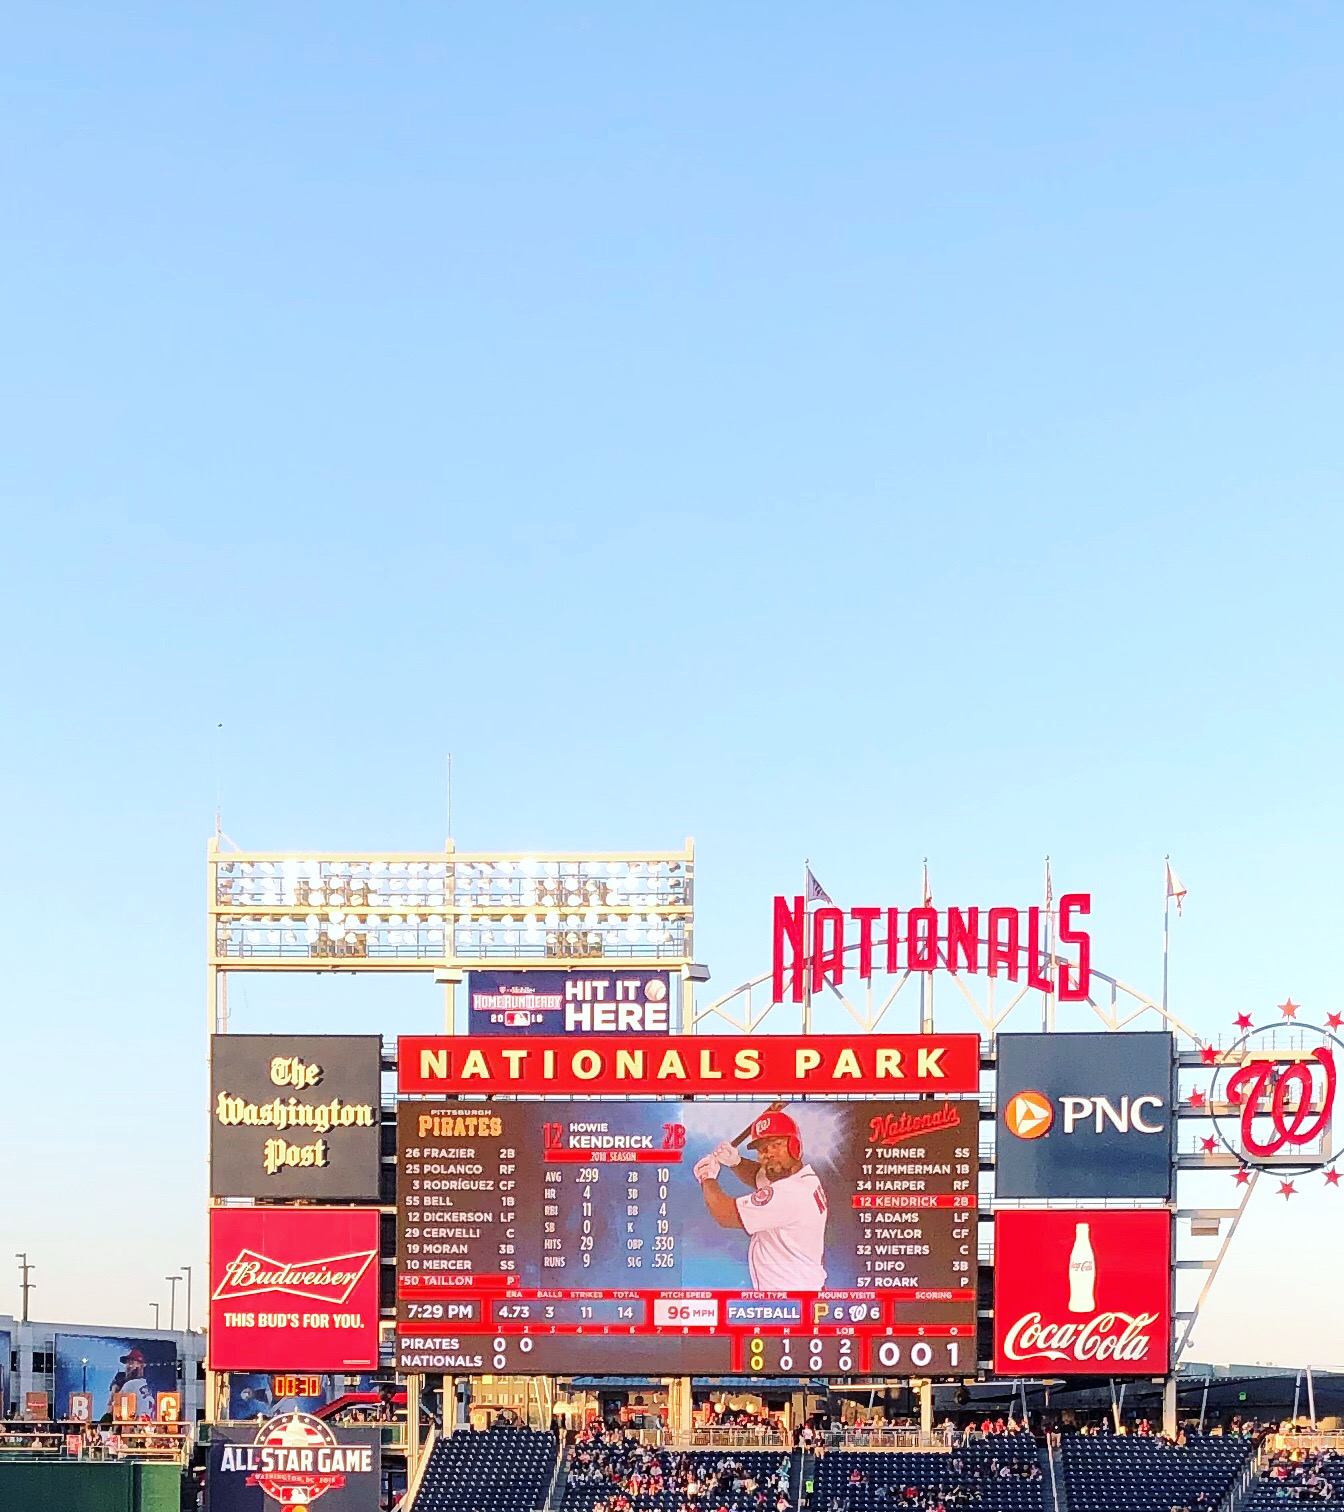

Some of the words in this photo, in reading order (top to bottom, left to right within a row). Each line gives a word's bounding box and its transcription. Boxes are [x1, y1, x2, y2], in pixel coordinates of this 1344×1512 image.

[772, 893, 1091, 1003] NATIONALS
[565, 979, 609, 1001] HIT
[616, 979, 641, 1001] IT
[564, 1002, 668, 1032] HERE
[419, 1049, 762, 1079] NATIONALS
[795, 1048, 948, 1079] PARK
[270, 1056, 321, 1090] The
[216, 1091, 375, 1134] Washington
[1059, 1096, 1164, 1134] PNC
[418, 1117, 502, 1138] PIRATES
[569, 1122, 608, 1133] HOWIE
[569, 1135, 653, 1149] KENDRICK
[264, 1138, 327, 1175] Post
[423, 1148, 475, 1159] FRAZIER
[876, 1148, 926, 1158] TURNER
[424, 1164, 483, 1175] POLANCO
[876, 1164, 951, 1175] ZIMMERMAN
[424, 1178, 494, 1191] RODRÍGUEZ
[876, 1180, 925, 1191] HARPER
[424, 1196, 453, 1207] BELL
[875, 1196, 938, 1206] KENDRICK
[424, 1212, 493, 1223] DICKERSON
[875, 1212, 919, 1223] ADAMS
[424, 1228, 480, 1239] CERVELLI
[875, 1229, 922, 1239] TAYLOR
[424, 1244, 468, 1255] MORAN
[875, 1244, 930, 1255] WIETERS
[424, 1260, 472, 1271] MERCER
[875, 1260, 905, 1271] DIFO
[226, 1261, 358, 1287] Budweiser
[424, 1276, 473, 1286] TAILLON
[875, 1277, 918, 1287] ROARK
[408, 1305, 445, 1319] 7:29
[448, 1305, 473, 1319] PM
[667, 1306, 690, 1319] 96
[692, 1309, 715, 1318] MPH
[728, 1307, 800, 1319] FASTBALL
[224, 1313, 255, 1327] THIS
[258, 1313, 299, 1328] BUD'S
[303, 1314, 330, 1328] FOR
[333, 1314, 365, 1329] YOU.
[1003, 1312, 1160, 1361] Coca-Cola
[401, 1338, 459, 1350] PIRATES
[401, 1355, 483, 1367] NATIONALS
[274, 1376, 321, 1397] 00:30
[221, 1448, 258, 1472] ALL
[261, 1448, 314, 1472] STAR
[318, 1448, 372, 1473] GAME
